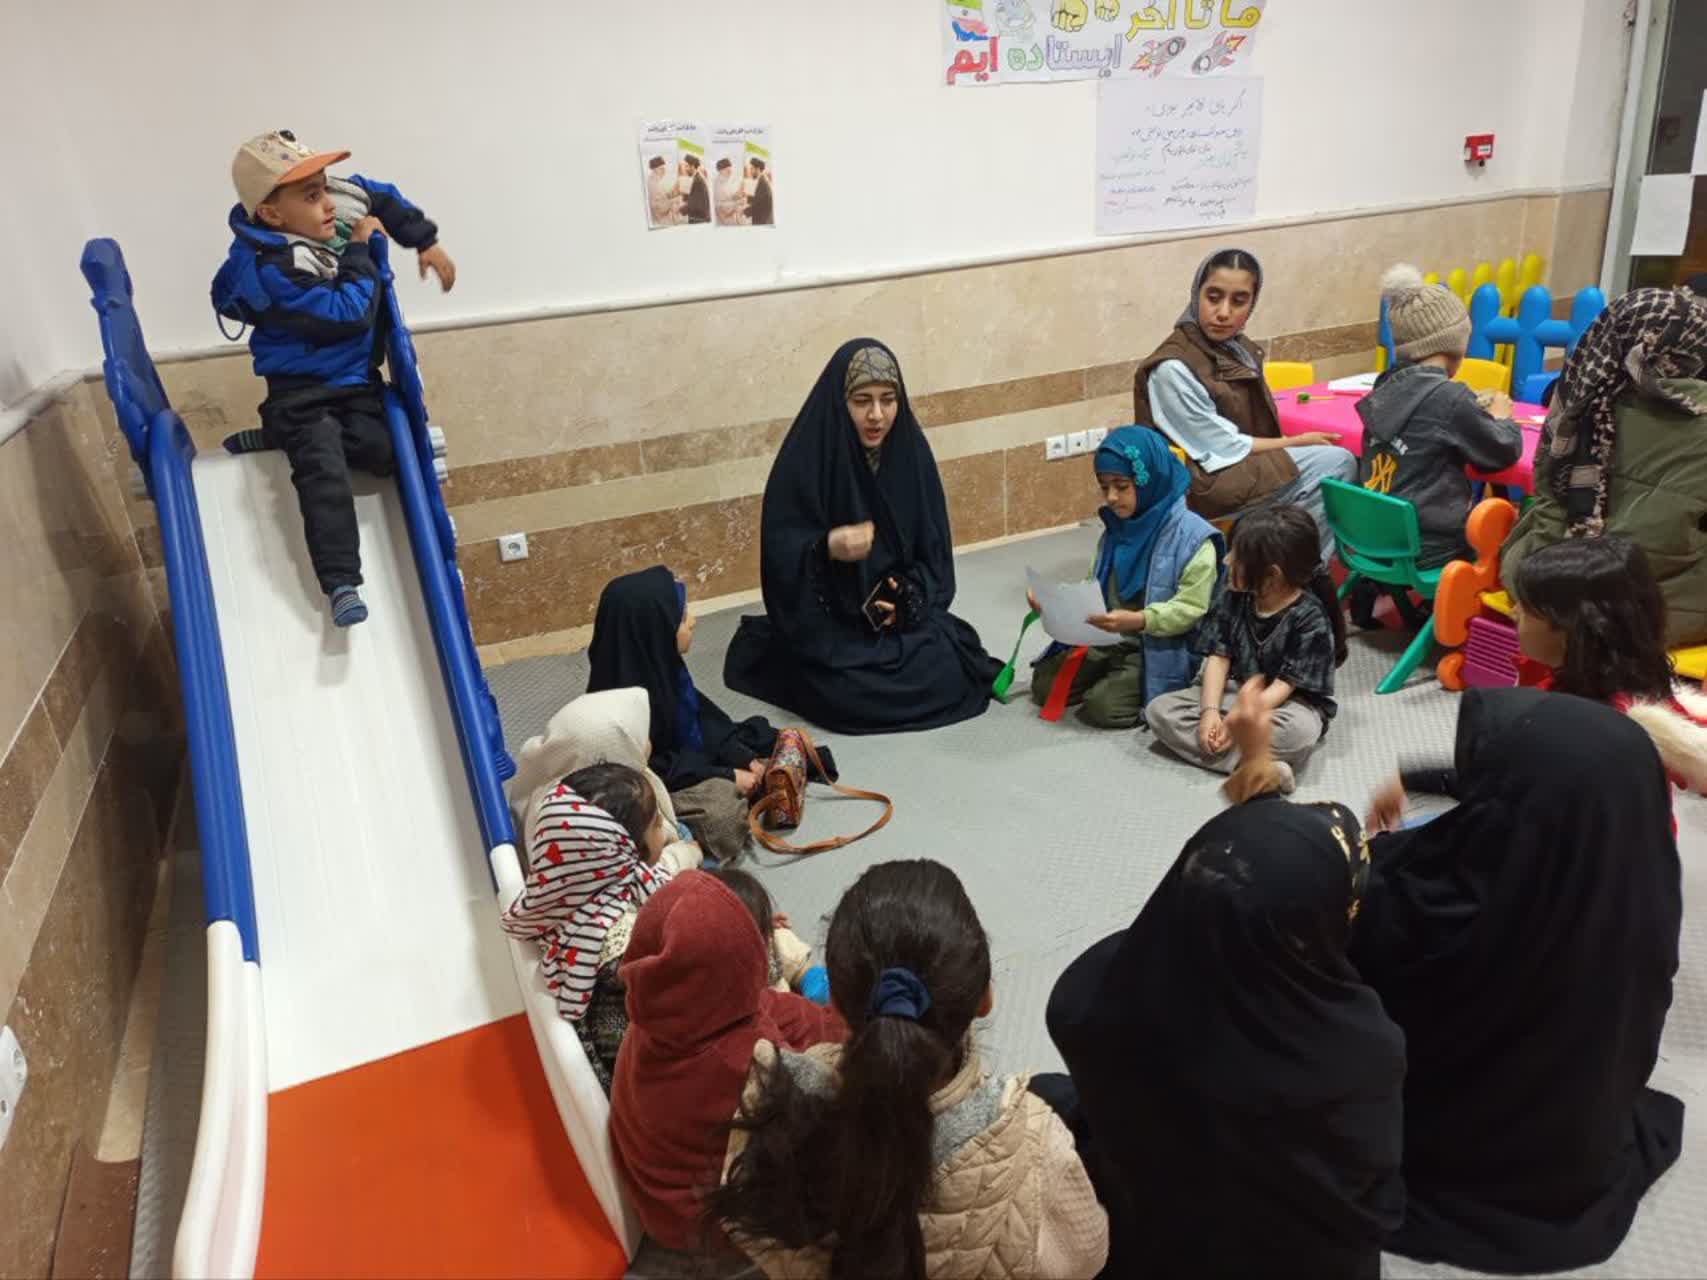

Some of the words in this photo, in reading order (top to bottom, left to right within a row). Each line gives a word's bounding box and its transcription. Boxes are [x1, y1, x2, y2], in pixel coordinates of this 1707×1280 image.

[1184, 0, 1217, 30] تا
[1220, 0, 1262, 29] ما
[946, 35, 999, 85] ایم
